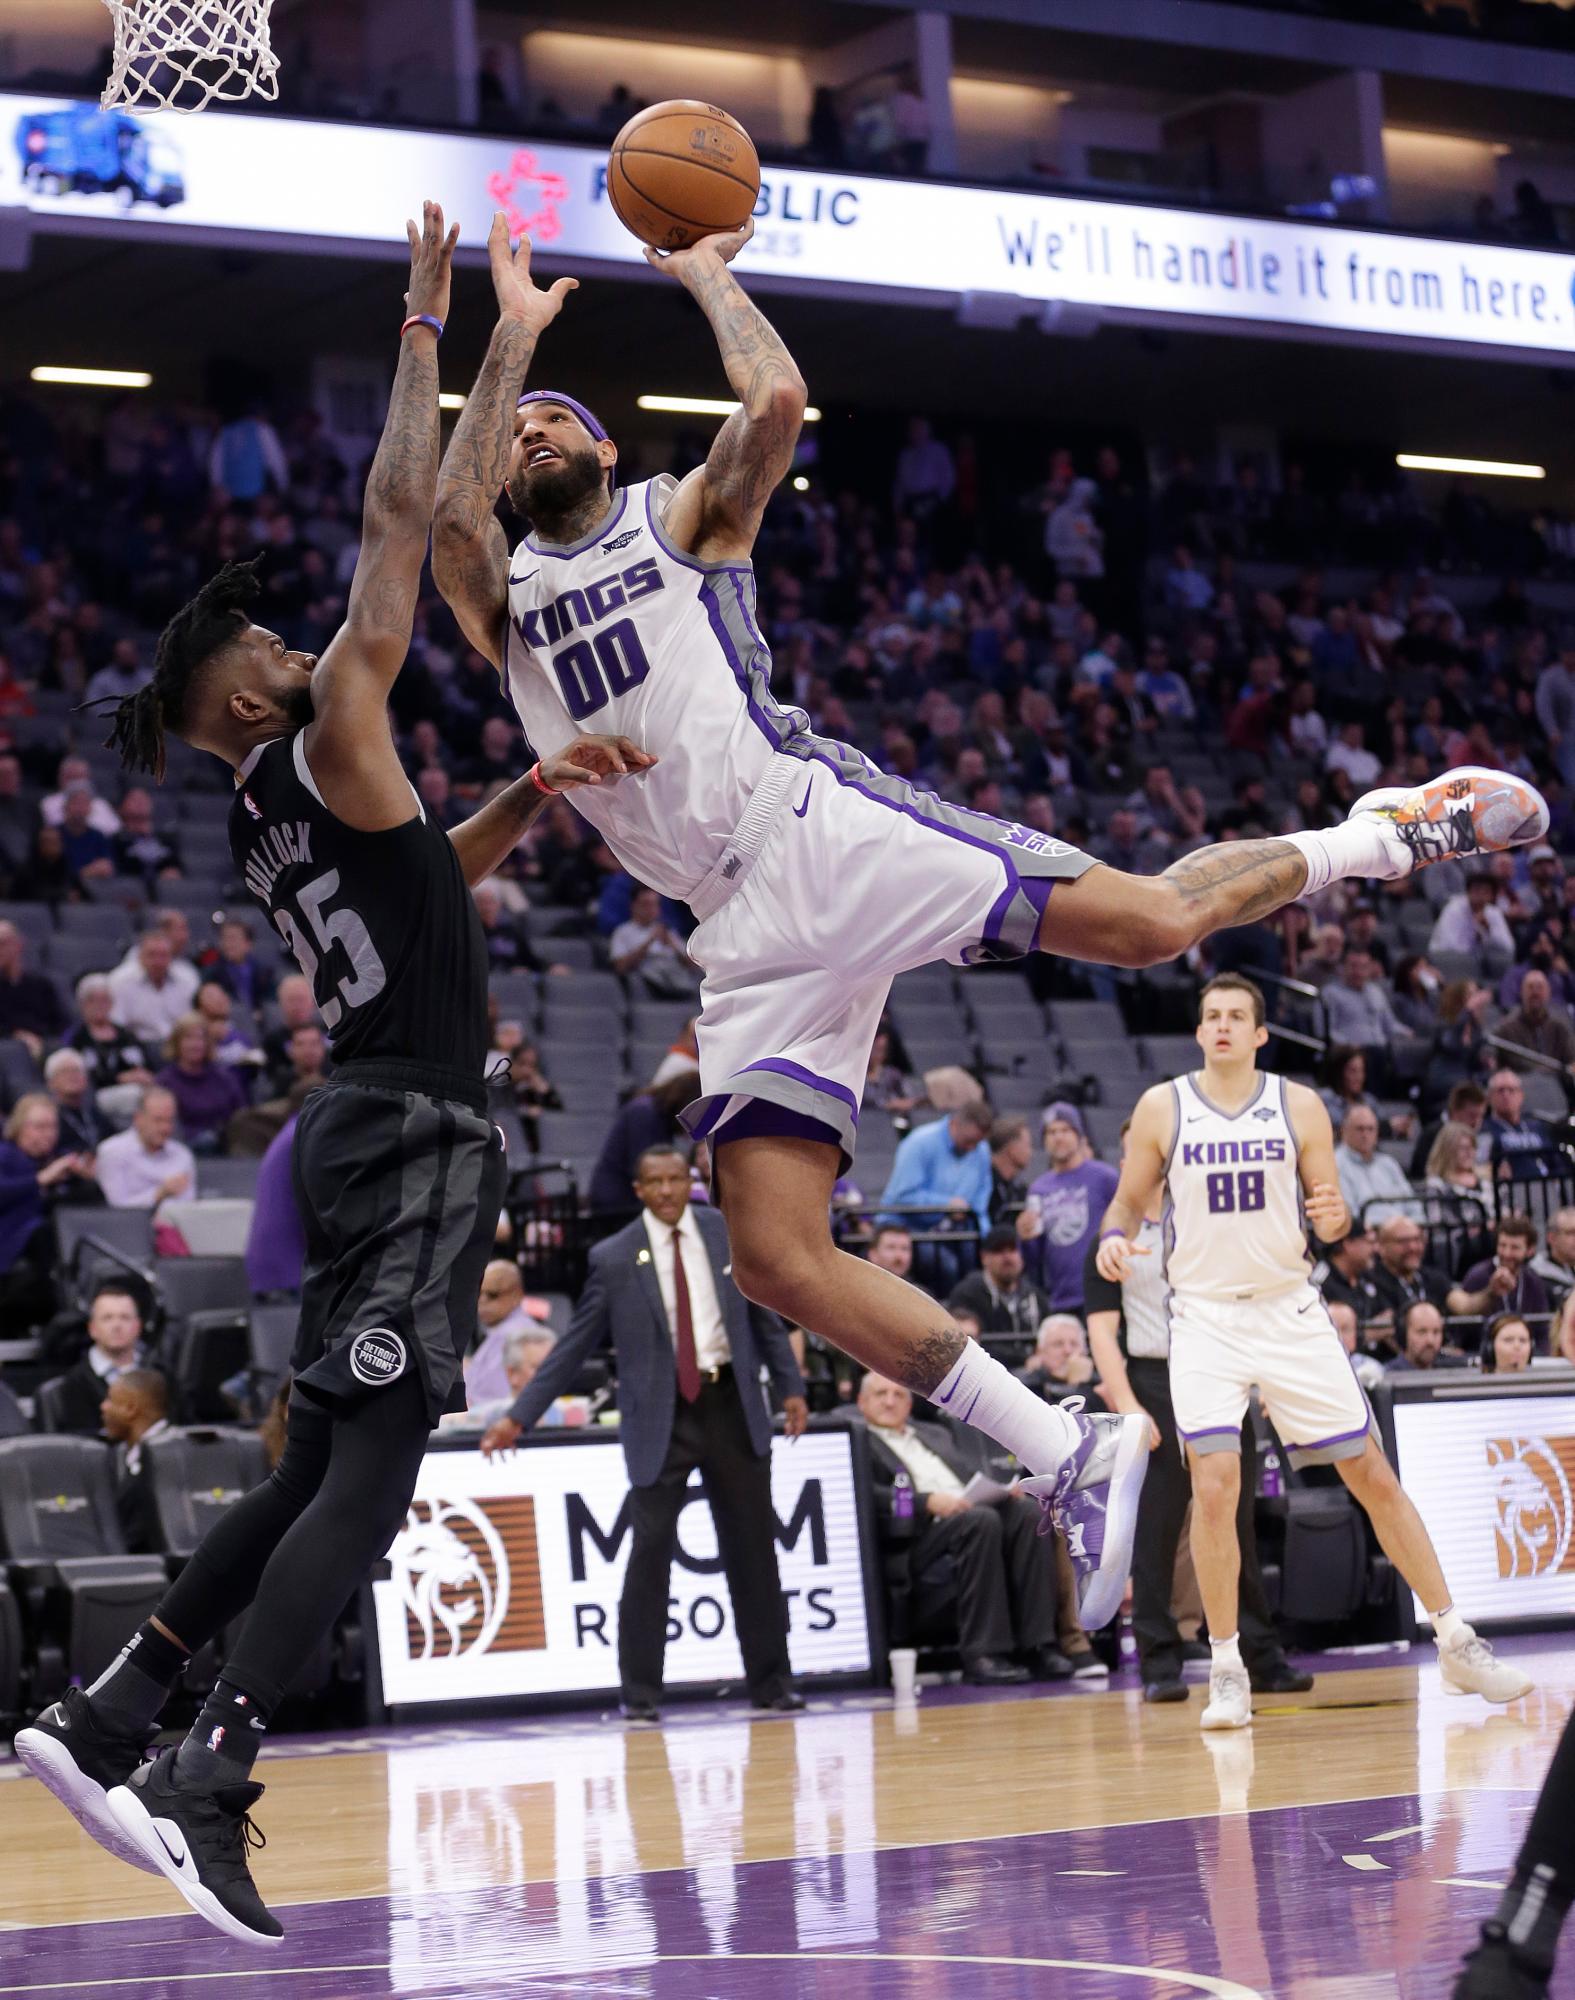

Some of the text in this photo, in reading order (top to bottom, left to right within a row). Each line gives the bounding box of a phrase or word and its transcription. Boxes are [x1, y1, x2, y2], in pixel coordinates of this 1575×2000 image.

[996, 213, 1560, 323] We'll handle it from here.
[513, 556, 665, 654] KINGS
[552, 617, 650, 721] 00
[273, 866, 387, 1030] 25
[1183, 1138, 1285, 1166] KINGS
[1206, 1169, 1265, 1213] 88
[358, 1349, 394, 1372] PISTONS
[363, 1340, 398, 1363] DETROIT
[574, 1587, 837, 1648] RSOS
